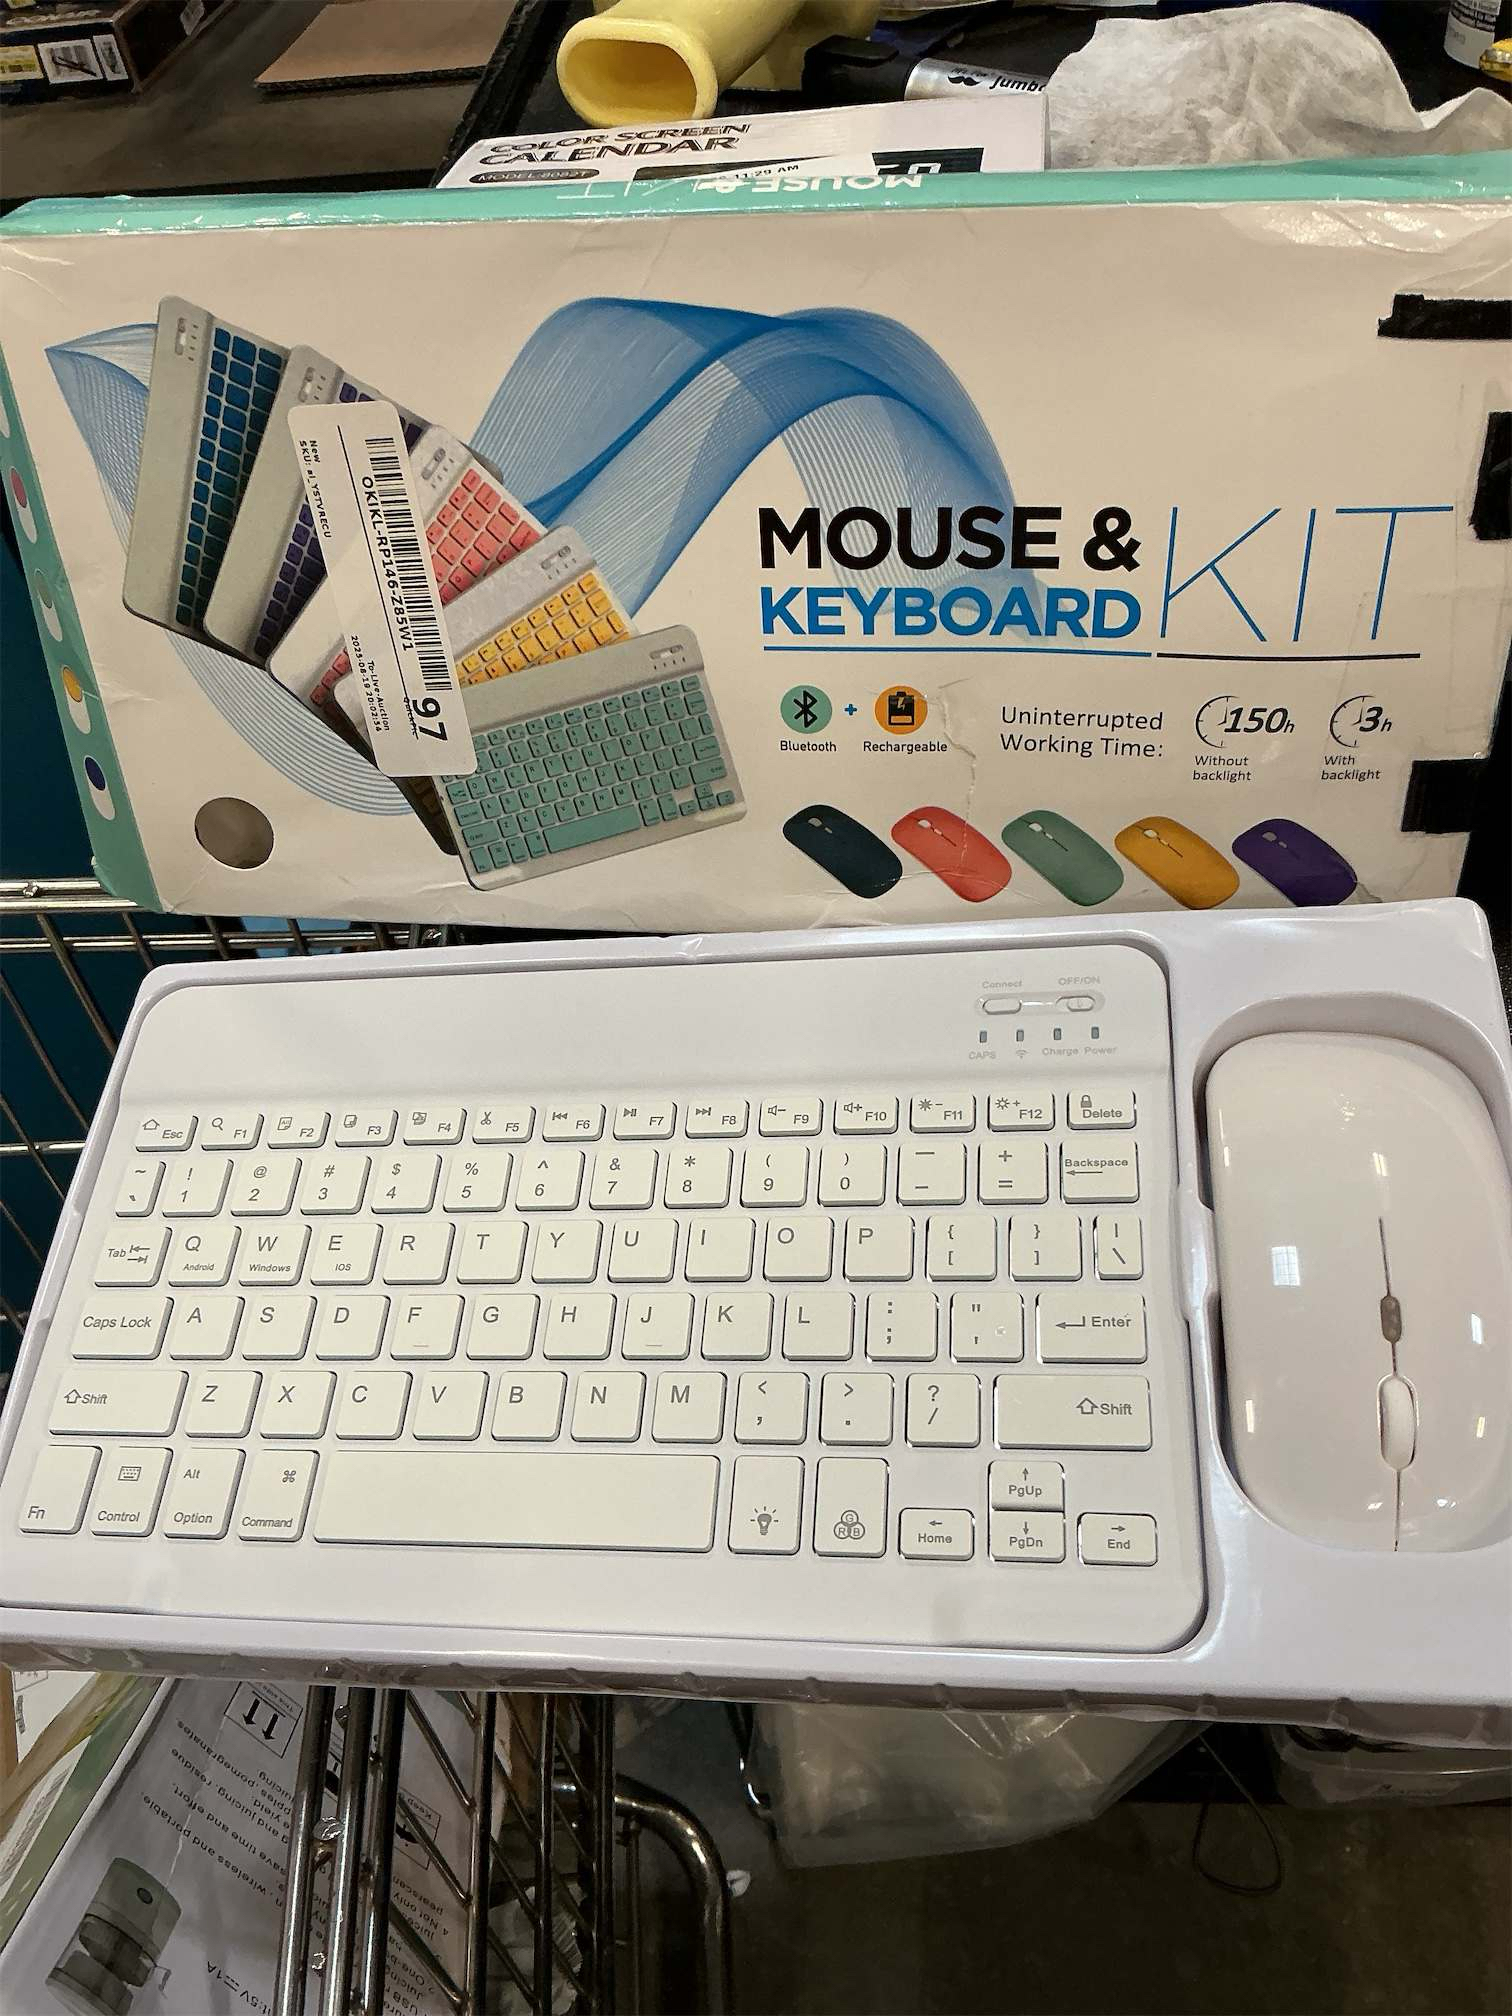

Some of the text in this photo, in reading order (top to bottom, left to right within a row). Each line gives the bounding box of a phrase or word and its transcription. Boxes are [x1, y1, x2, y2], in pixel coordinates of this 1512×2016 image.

[489, 123, 750, 153] COLOR SCREEN
[479, 136, 741, 165] CALENDAR
[777, 164, 799, 173] AM
[299, 440, 312, 466] SKU:
[309, 440, 321, 463] New
[760, 506, 1141, 572] MOUSE &
[1160, 505, 1454, 642] KIT
[761, 586, 1142, 638] KEYBOARD
[412, 697, 448, 742] 97
[1001, 706, 1163, 732] Uninterrupted
[1223, 706, 1295, 734] 150h
[1358, 706, 1393, 733] 3h
[780, 740, 837, 752] Bluetooth
[863, 740, 948, 754] Rechargeable
[1000, 733, 1163, 758] Working Time:
[1195, 755, 1249, 767] Without
[1324, 754, 1356, 766] With
[1192, 769, 1252, 783] backlight
[1321, 768, 1381, 782] backlight
[981, 980, 1023, 989] Connect
[1057, 976, 1100, 986] OFF/ON
[968, 1051, 997, 1060] CAPS
[1042, 1048, 1079, 1057] Charge
[1084, 1046, 1117, 1055] Power
[721, 1115, 737, 1125] F8
[793, 1114, 810, 1125] F9
[865, 1111, 887, 1121] F10
[943, 1110, 963, 1121] F11
[1019, 1108, 1043, 1120] F12
[1083, 1108, 1122, 1119] Delete
[437, 1122, 452, 1133] F4
[505, 1122, 520, 1133] F5
[575, 1119, 591, 1130] F6
[649, 1116, 665, 1126] F7
[161, 1129, 184, 1139] Esc
[233, 1129, 248, 1139] F1
[299, 1127, 314, 1138] F2
[367, 1125, 382, 1136] F3
[391, 1162, 402, 1176] $
[465, 1162, 479, 1176] %
[609, 1157, 621, 1171] &
[1064, 1158, 1129, 1169] Backspace
[253, 1165, 268, 1179] @
[323, 1164, 336, 1178] #
[534, 1183, 545, 1197] 6
[607, 1180, 618, 1195] 7
[682, 1179, 692, 1193] 8
[763, 1177, 774, 1192] 9
[181, 1190, 188, 1203] 1
[247, 1188, 261, 1202] 2
[318, 1187, 328, 1201] 3
[386, 1185, 396, 1199] 4
[461, 1185, 472, 1199] 5
[327, 1235, 344, 1251] E
[400, 1235, 416, 1251] R
[476, 1233, 491, 1250] T
[550, 1232, 565, 1249] Y
[624, 1230, 640, 1247] U
[700, 1229, 706, 1246] I
[777, 1227, 795, 1245] O
[858, 1227, 874, 1245] P
[184, 1235, 202, 1252] Q
[258, 1236, 279, 1252] W
[108, 1248, 127, 1258] Tab
[183, 1263, 215, 1271] Android
[249, 1264, 291, 1272] Windows
[186, 1307, 202, 1324] A
[259, 1306, 275, 1324] S
[333, 1307, 350, 1324] D
[407, 1306, 423, 1324] F
[482, 1306, 500, 1323] G
[560, 1305, 577, 1323] H
[640, 1306, 652, 1324] J
[717, 1305, 734, 1323] K
[798, 1306, 811, 1324] L
[83, 1315, 152, 1331] Caps Lock
[1092, 1316, 1132, 1328] Enter
[82, 1393, 107, 1404] Shift
[201, 1385, 219, 1403] Z
[277, 1385, 295, 1403] X
[351, 1385, 368, 1403] C
[431, 1385, 448, 1404] V
[509, 1385, 524, 1404] B
[590, 1385, 607, 1405] N
[670, 1384, 691, 1404] M
[927, 1384, 940, 1402] ?
[1100, 1404, 1132, 1416] Shift
[183, 1468, 201, 1479] Alt
[1008, 1484, 1043, 1498] PgUp
[27, 1505, 46, 1519] Fn
[97, 1510, 141, 1522] Control
[173, 1511, 213, 1525] Option
[241, 1516, 294, 1528] Command
[917, 1532, 953, 1544] Home
[1009, 1536, 1043, 1550] PgDn
[1107, 1538, 1131, 1550] End
[171, 1748, 213, 1787] residue
[206, 1812, 230, 1833] and
[257, 1816, 279, 1837] and
[192, 1836, 216, 1856] and
[231, 1831, 257, 1855] time
[217, 1855, 266, 1895] wireless
[393, 1892, 417, 1914] only
